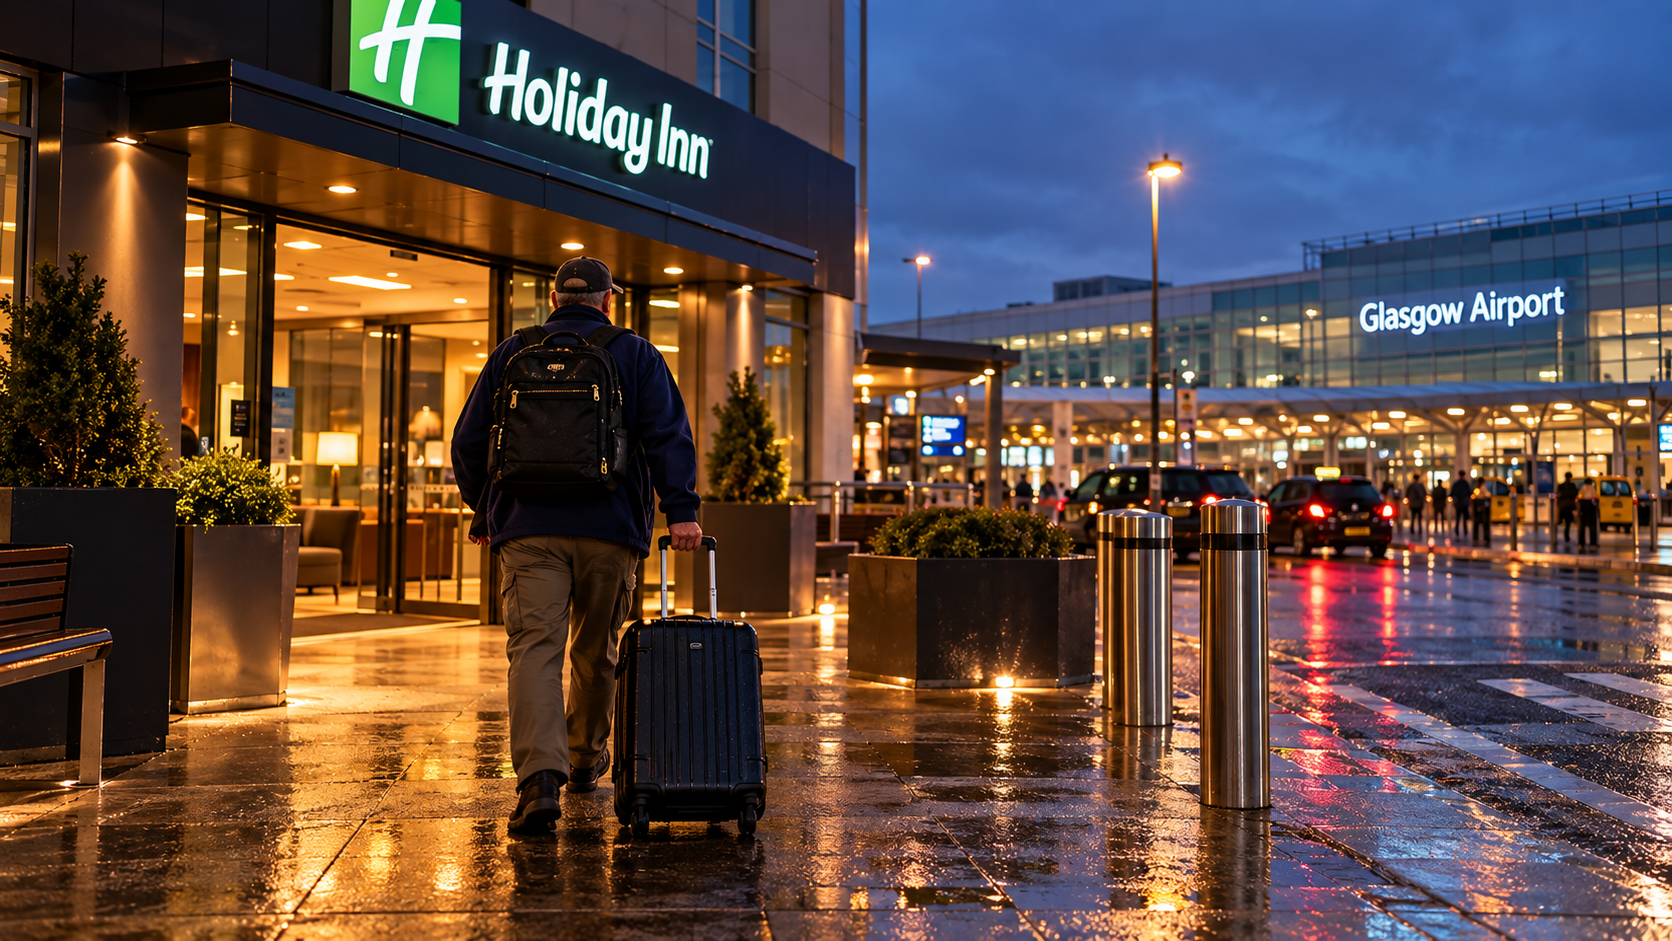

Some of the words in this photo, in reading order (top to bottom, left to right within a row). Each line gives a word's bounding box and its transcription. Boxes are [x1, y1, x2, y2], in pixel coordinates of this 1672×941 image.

[484, 41, 653, 175] Holiday
[657, 102, 710, 180] Inn
[1359, 301, 1464, 336] Glasgow
[1469, 286, 1565, 328] Airport
